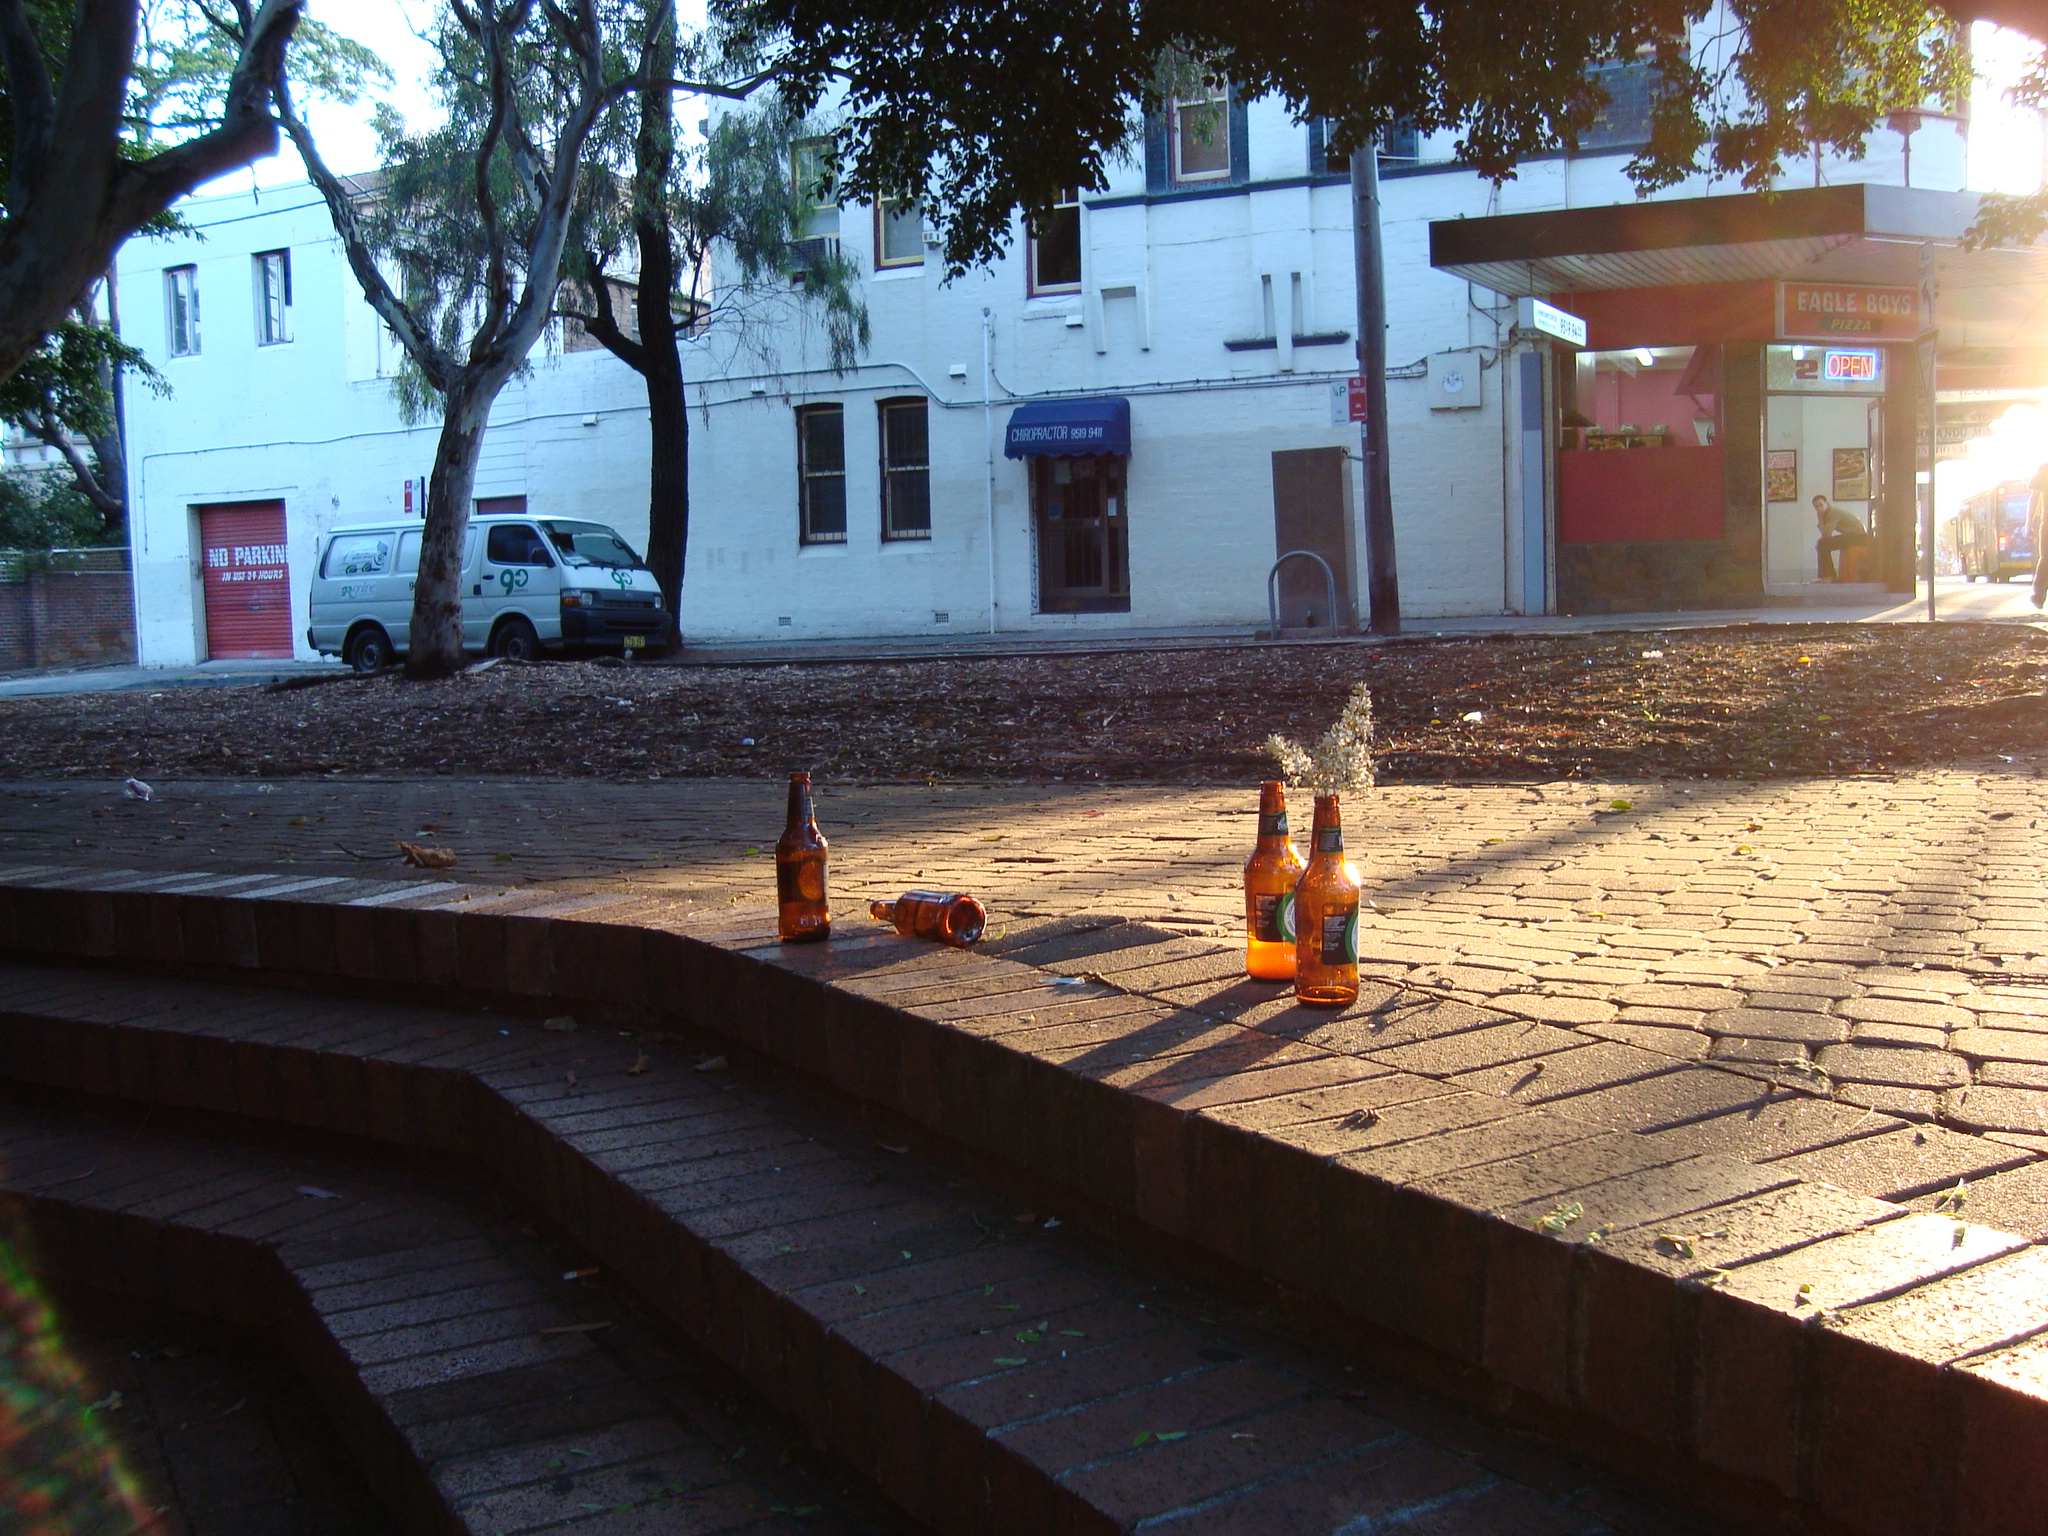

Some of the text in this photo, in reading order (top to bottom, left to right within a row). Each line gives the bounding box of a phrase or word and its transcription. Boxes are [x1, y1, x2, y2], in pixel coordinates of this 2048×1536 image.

[1797, 290, 1911, 315] EAGLE BOYS
[1830, 318, 1872, 331] PIZZA
[1828, 354, 1873, 377] OPEN
[1011, 426, 1103, 442] CHIROPRACTOR 9519 9411
[209, 547, 229, 568] NO
[222, 571, 232, 582] IN
[233, 571, 246, 581] USE
[258, 569, 284, 580] HOURS
